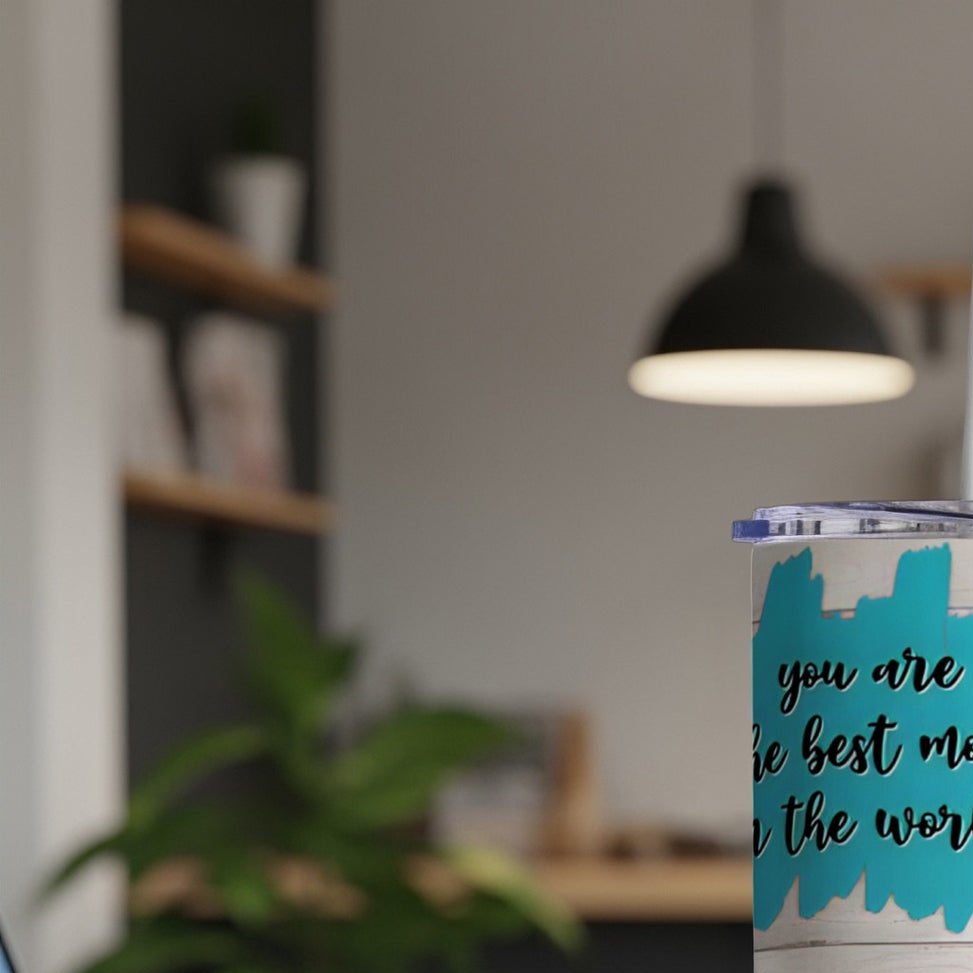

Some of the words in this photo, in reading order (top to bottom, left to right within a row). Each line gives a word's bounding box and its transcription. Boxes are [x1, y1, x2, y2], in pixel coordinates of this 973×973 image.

[777, 659, 859, 715] you
[871, 647, 964, 693] are
[801, 714, 903, 776] best
[780, 790, 858, 857] the
